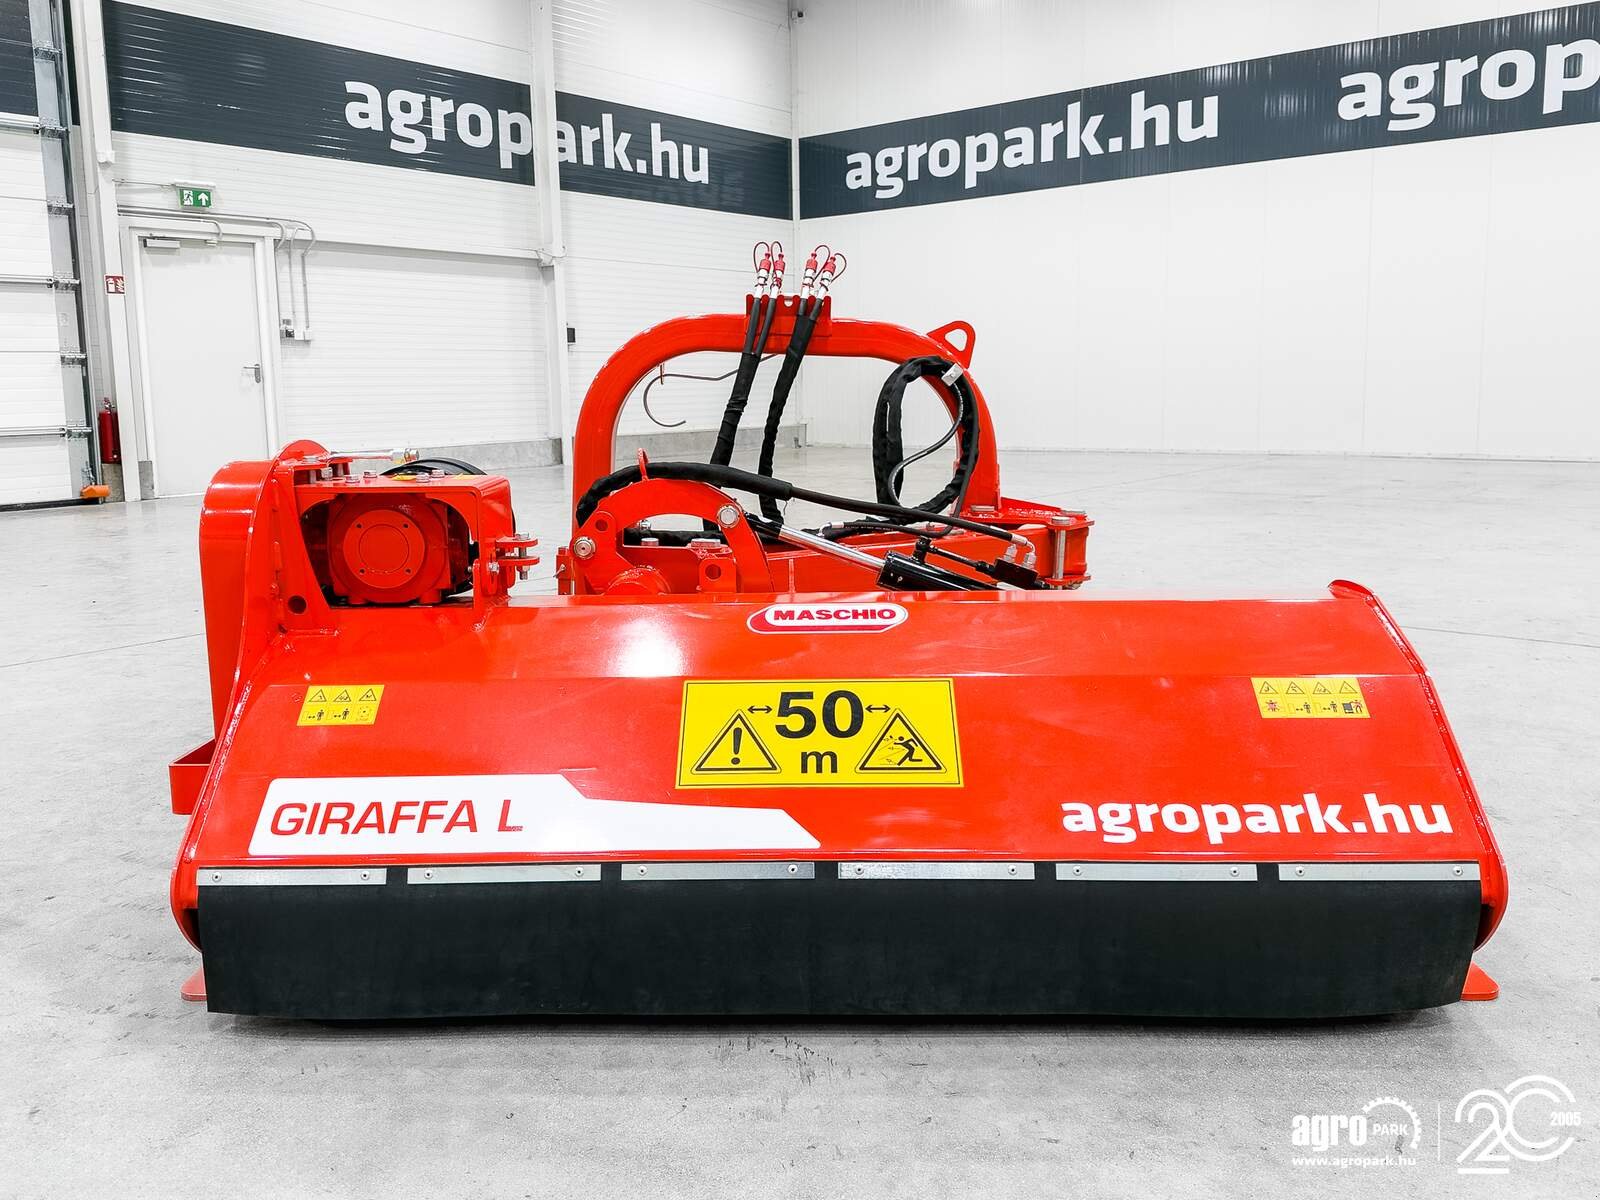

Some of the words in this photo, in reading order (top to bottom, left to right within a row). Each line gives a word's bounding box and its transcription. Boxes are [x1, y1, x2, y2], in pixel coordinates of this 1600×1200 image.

[344, 81, 709, 185] agropark.hu
[845, 90, 1219, 199] agropark.hu
[773, 608, 897, 621] MASCHIO
[774, 689, 864, 740] 50
[800, 750, 838, 774] m
[270, 799, 478, 836] GIRAFFA
[497, 799, 524, 832] L
[1060, 792, 1454, 845] agropark.hu
